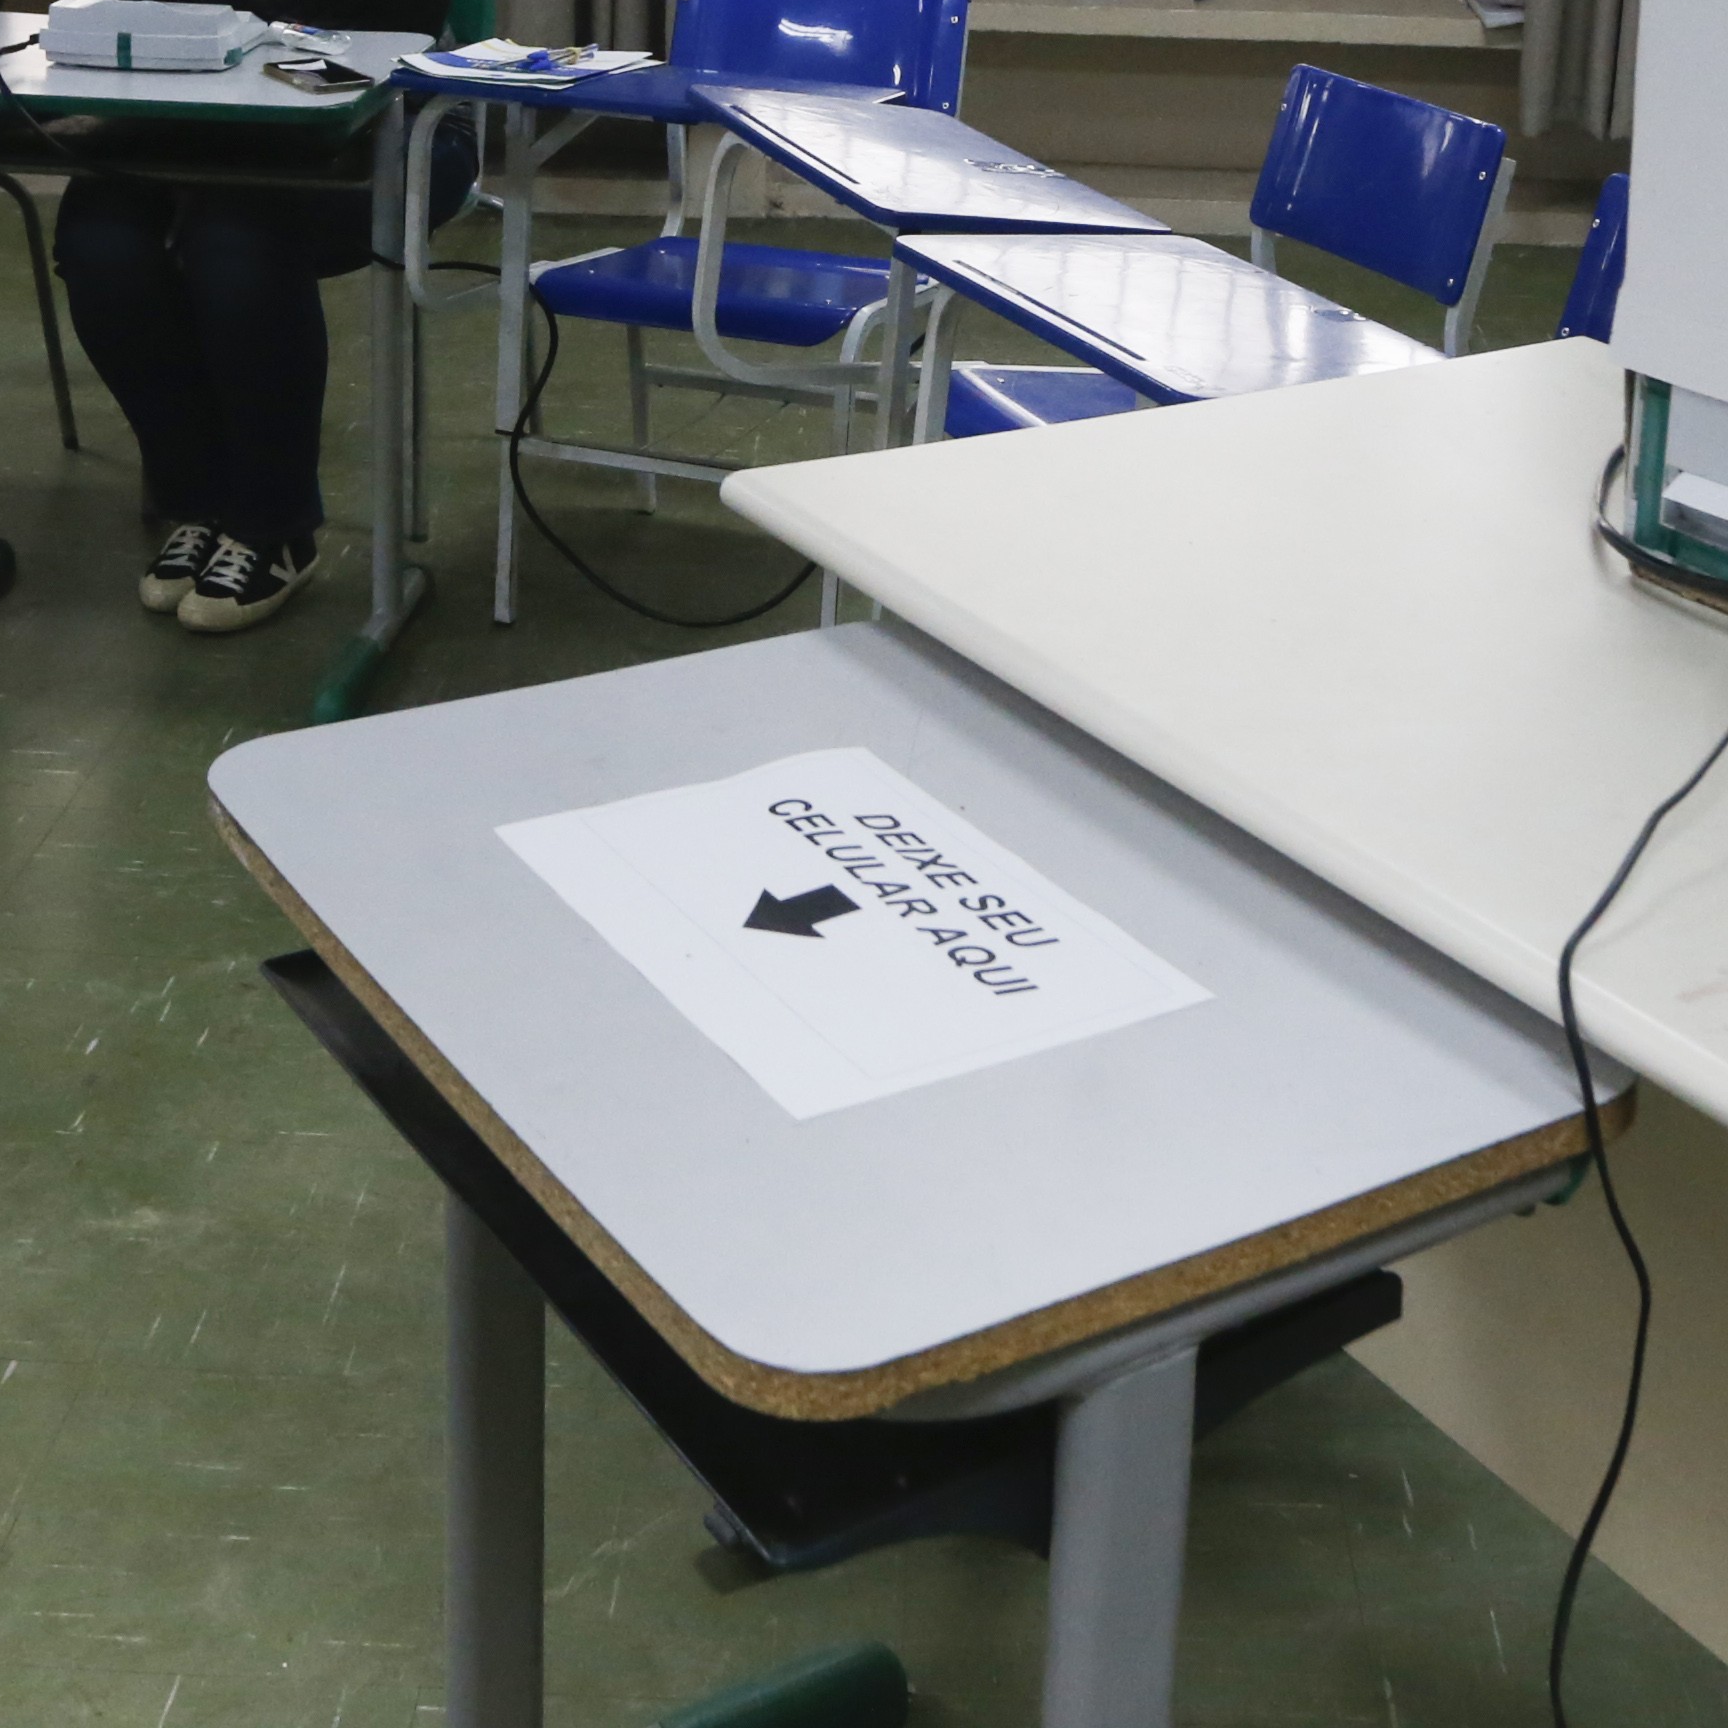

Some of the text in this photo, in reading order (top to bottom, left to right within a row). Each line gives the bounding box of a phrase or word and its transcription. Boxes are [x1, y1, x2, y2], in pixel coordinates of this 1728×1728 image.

[767, 797, 1039, 996] CELULAR AQUI
[854, 813, 1060, 949] DEIXE SEU
